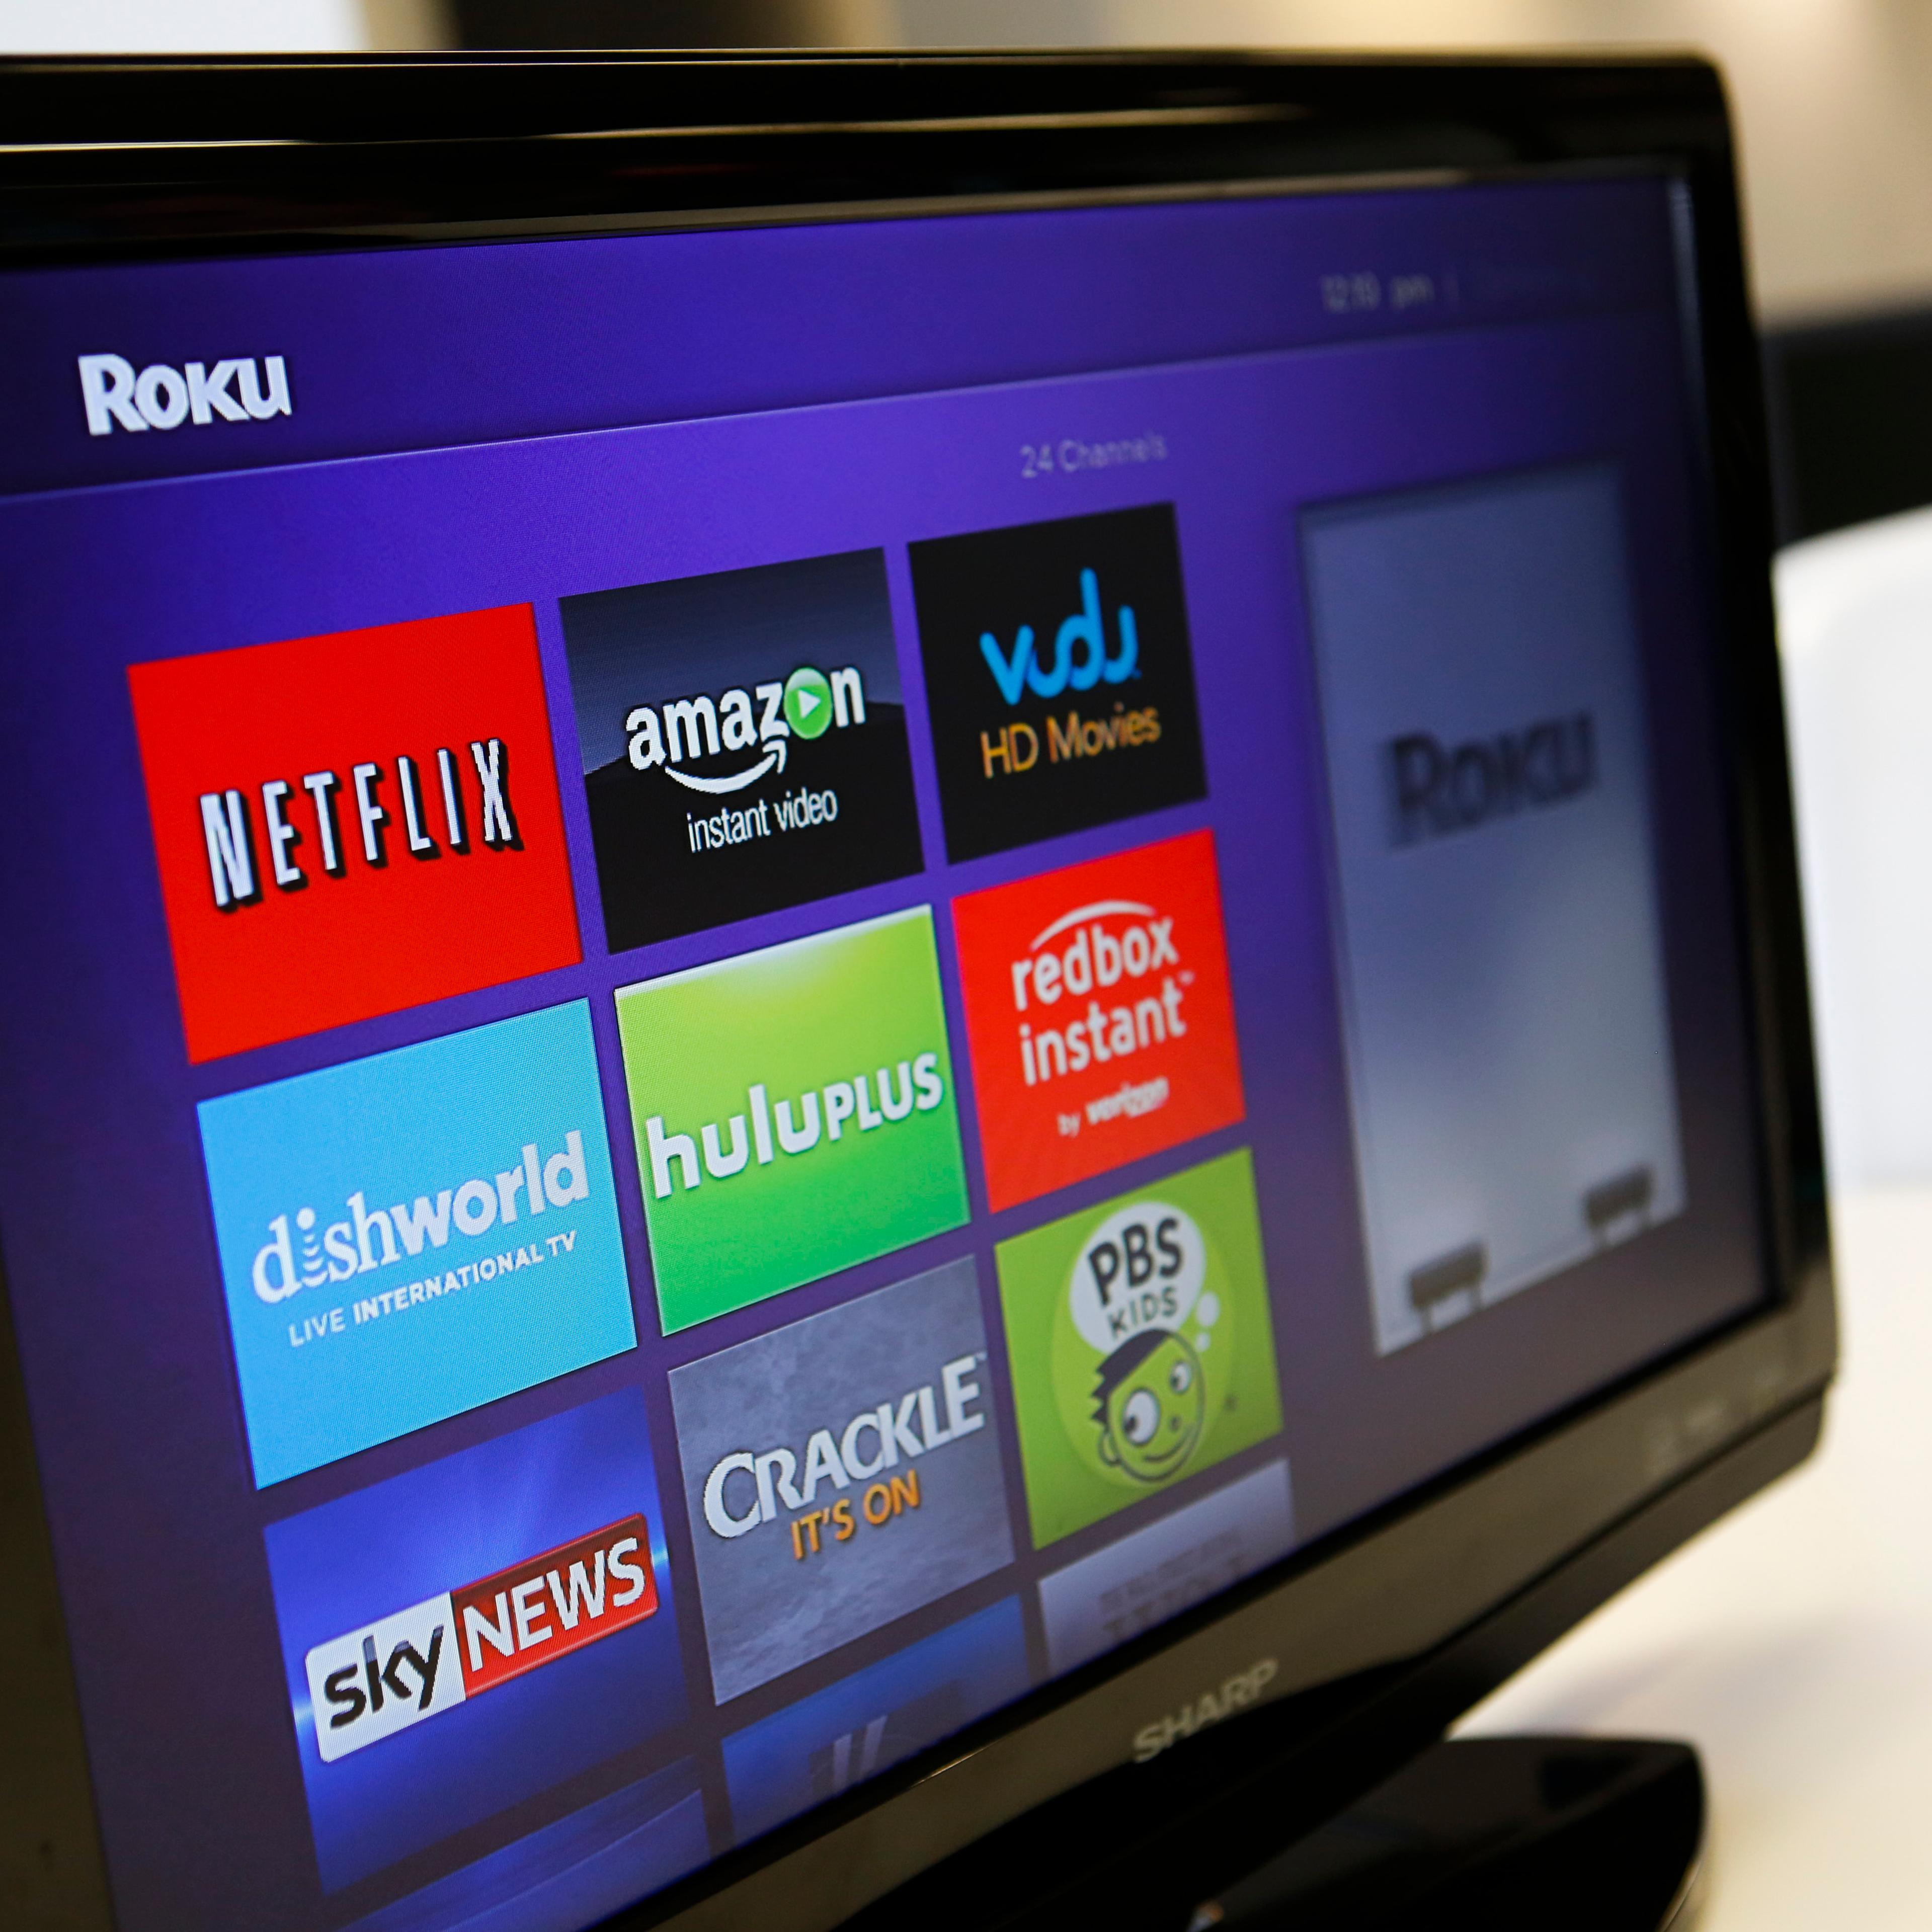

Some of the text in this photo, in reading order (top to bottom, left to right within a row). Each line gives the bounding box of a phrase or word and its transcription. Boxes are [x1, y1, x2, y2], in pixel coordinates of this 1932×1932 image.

[1020, 431, 1168, 478] 24 Channels
[979, 567, 1139, 705] vudu
[625, 667, 866, 770] amazon
[980, 700, 1162, 780] HD Movies
[200, 738, 524, 913] NETFLIX
[687, 787, 839, 853] instant video
[1011, 916, 1180, 1011] redbox
[1019, 978, 1187, 1087] instant
[1057, 1113, 1081, 1138] by
[252, 1130, 590, 1304] dishworld
[1088, 1217, 1184, 1307] PBS
[289, 1231, 577, 1347] LIVE INTERNATIONAL TV
[1108, 1286, 1179, 1341] KIDS
[704, 1355, 985, 1538] CRACKLE
[791, 1469, 920, 1560] IT'S ON
[324, 1537, 647, 1729] sky NEWS
[1133, 1660, 1278, 1763] SHARP
